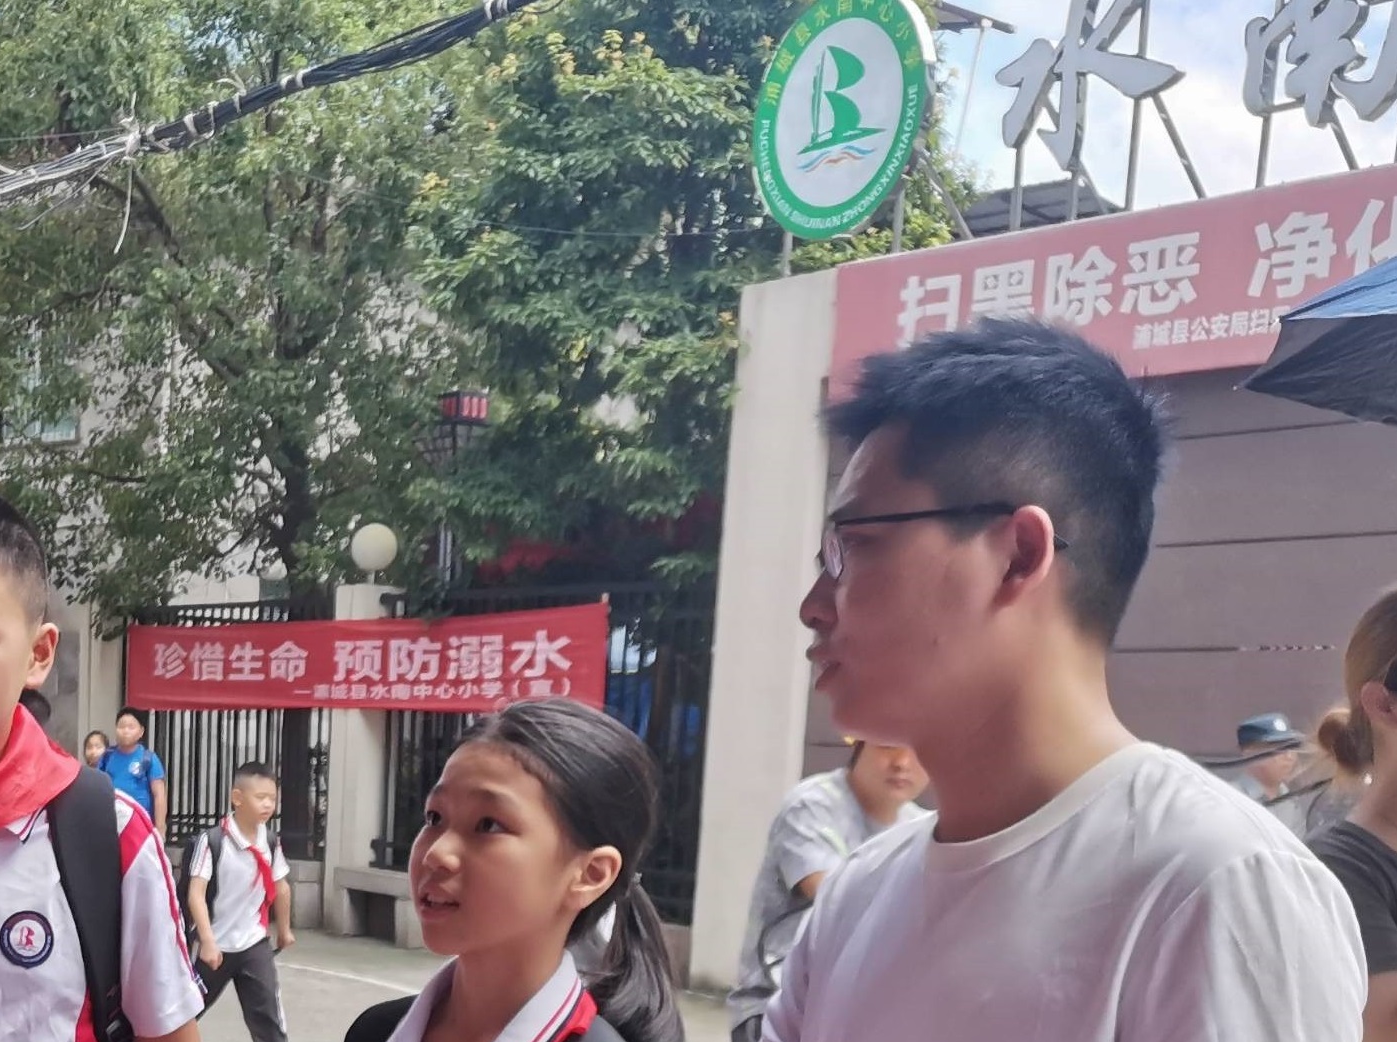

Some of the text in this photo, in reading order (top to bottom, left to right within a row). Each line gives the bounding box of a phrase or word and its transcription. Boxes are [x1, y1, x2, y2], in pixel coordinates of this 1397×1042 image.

[896, 231, 1202, 348] 扫黑除恶
[153, 629, 572, 682] 珍惜生命 预防溺水
